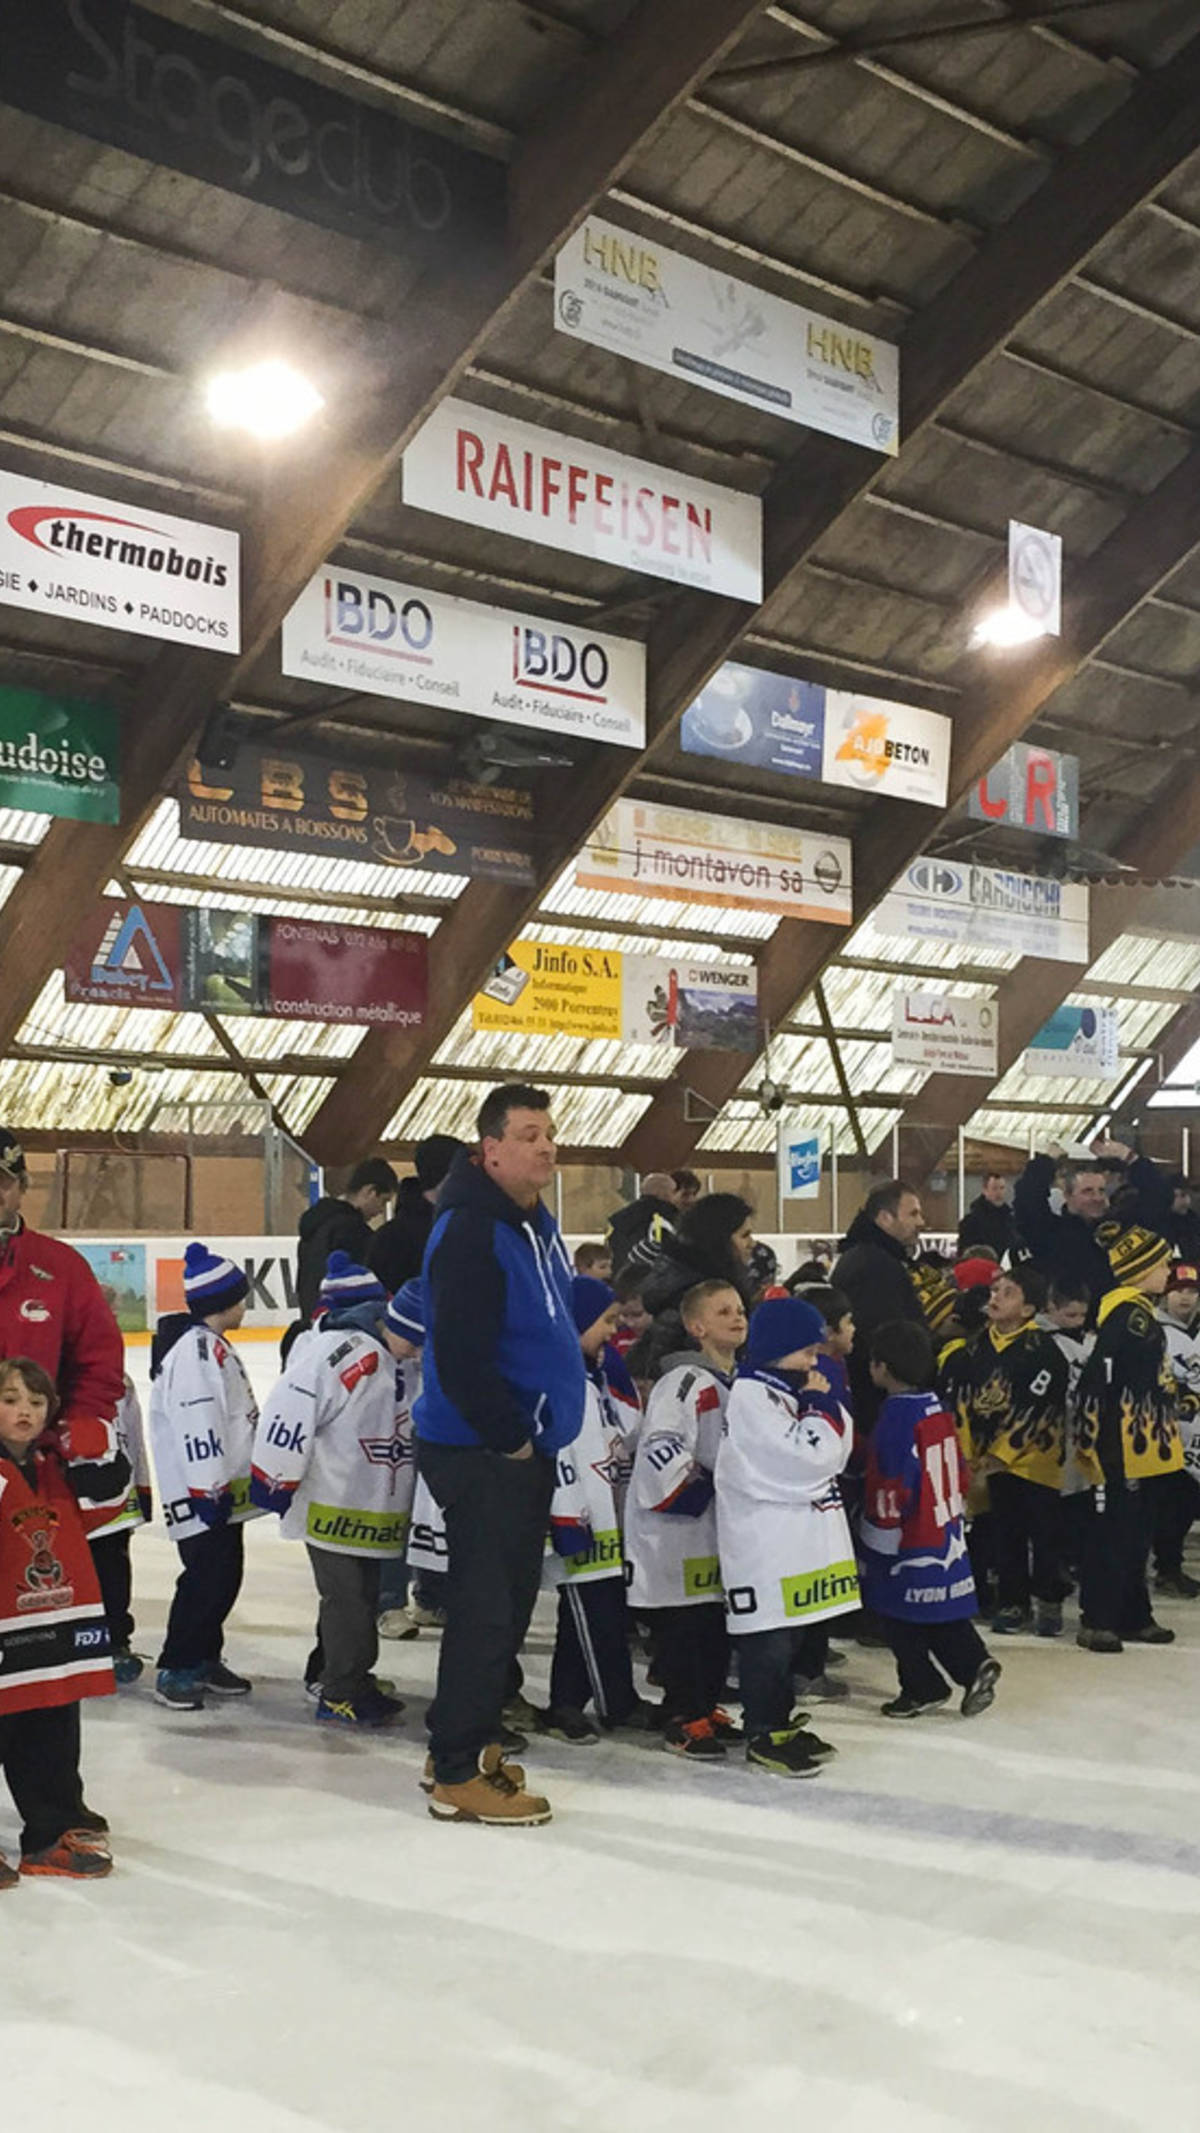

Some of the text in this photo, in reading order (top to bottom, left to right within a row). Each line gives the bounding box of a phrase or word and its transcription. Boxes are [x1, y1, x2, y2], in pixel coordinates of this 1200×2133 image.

[456, 429, 713, 565] RAIFFEISEN
[50, 520, 228, 588] thermobois
[45, 582, 118, 613] JARDINS
[140, 604, 229, 638] PADDOCKS
[336, 582, 434, 650] BDO
[301, 650, 336, 669] Audit
[416, 672, 460, 698] Conseil
[524, 628, 609, 690] BDO
[492, 691, 632, 733] Audit Fiduciaire Conseil
[188, 805, 279, 833] AUTOMATES
[295, 820, 369, 845] BOISSONS
[654, 849, 771, 889] montavon
[780, 868, 804, 894] sa
[532, 947, 619, 979] Jinfo S.A.
[699, 969, 749, 988] WENGER
[274, 1000, 354, 1020] construction
[356, 1002, 423, 1028] métallique
[1029, 1369, 1051, 1396] 8
[184, 1428, 225, 1463] ibk
[267, 1414, 307, 1455] ibk
[925, 1436, 965, 1528] 11
[904, 1587, 948, 1603] LYON
[74, 1629, 102, 1647] FDJ
